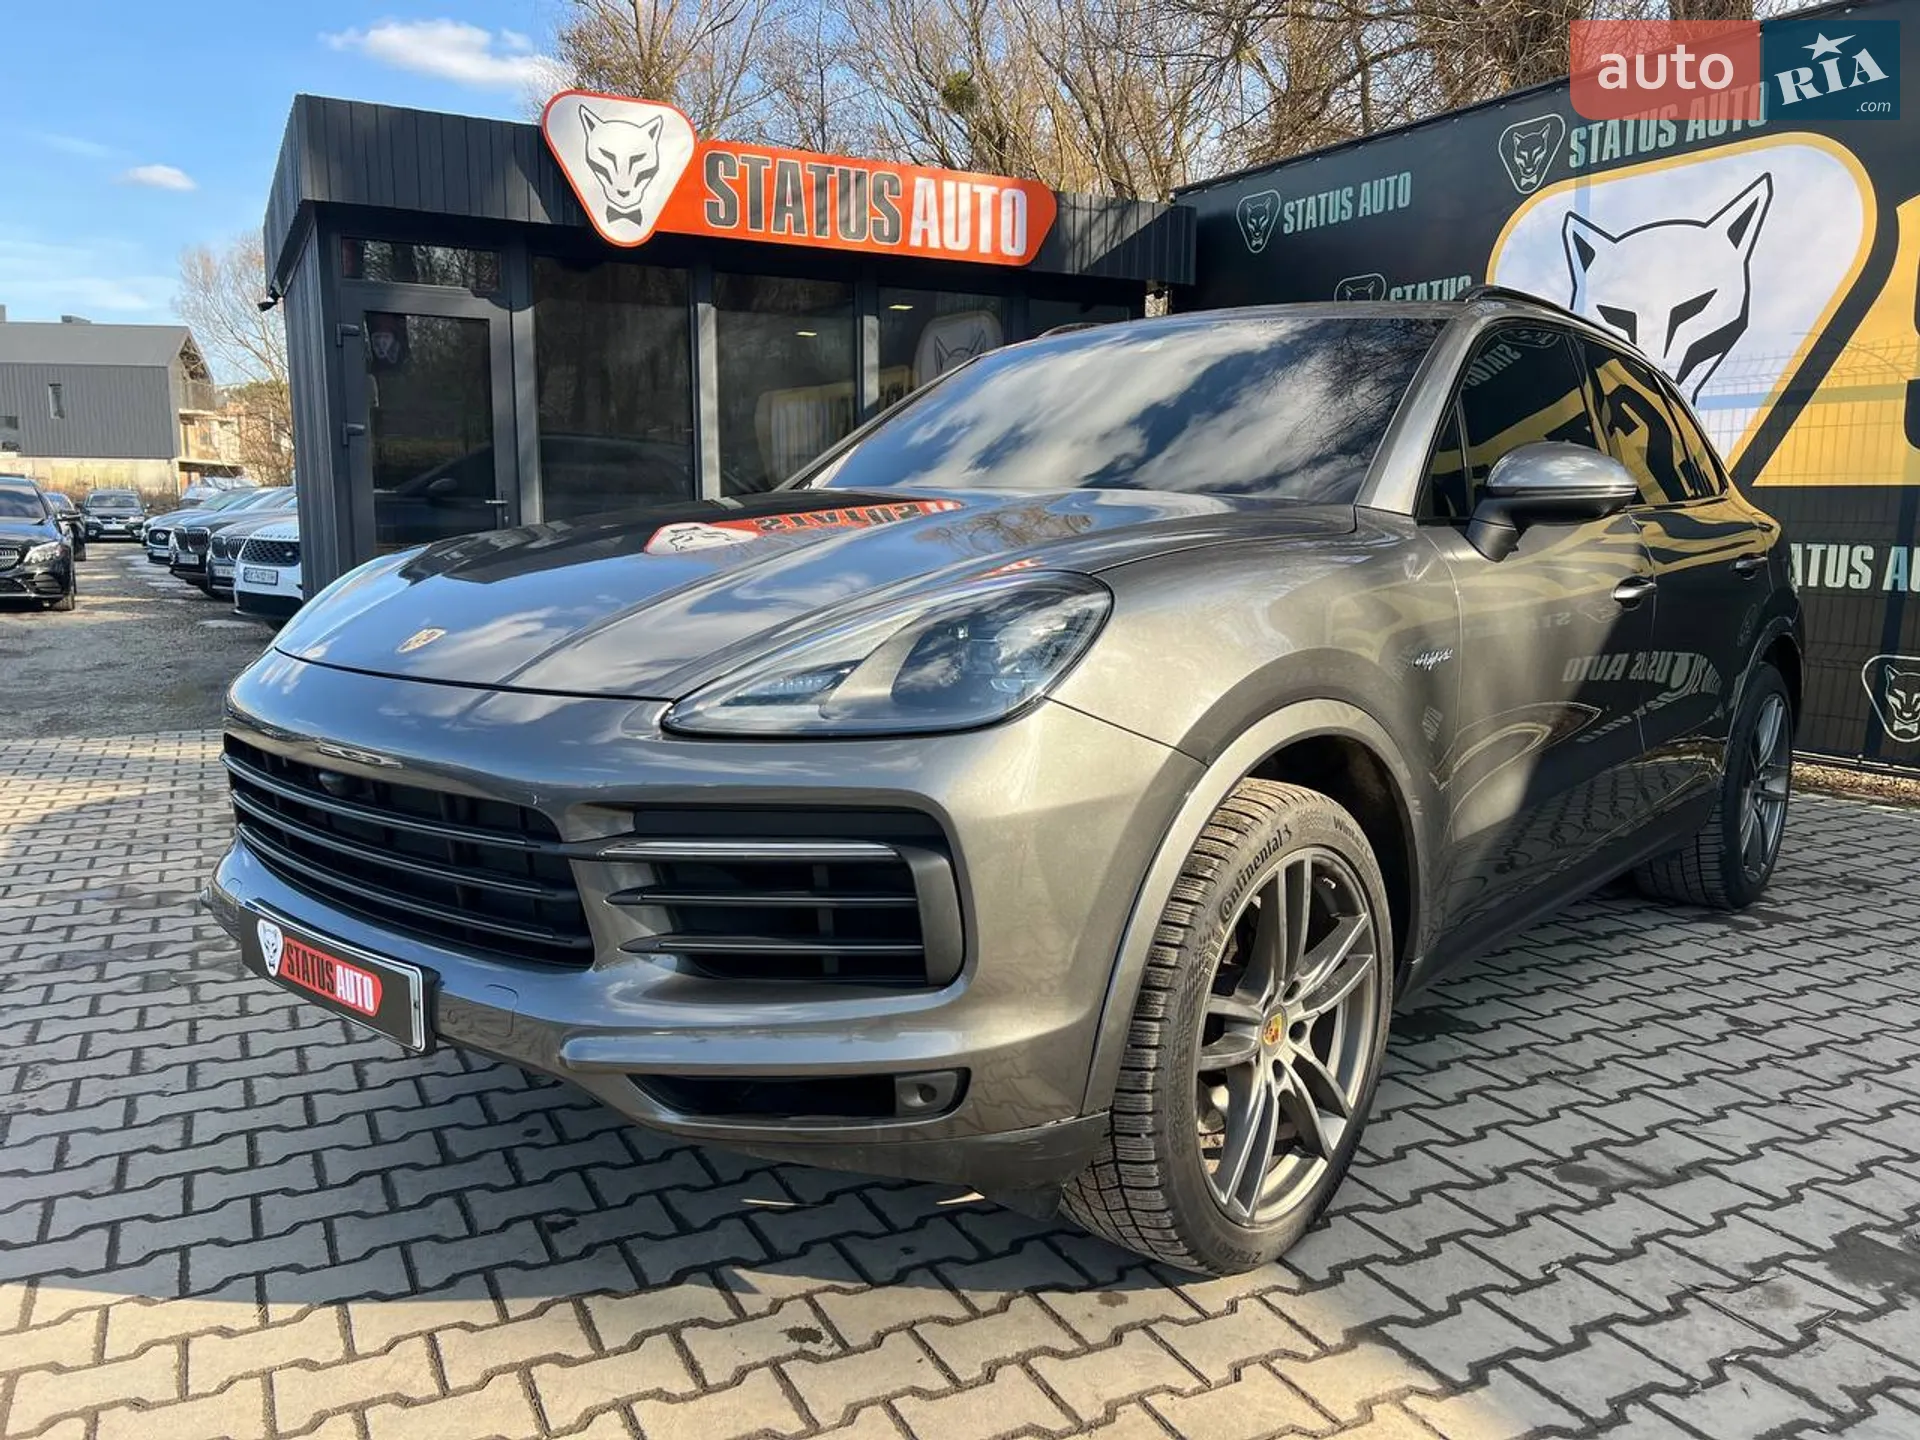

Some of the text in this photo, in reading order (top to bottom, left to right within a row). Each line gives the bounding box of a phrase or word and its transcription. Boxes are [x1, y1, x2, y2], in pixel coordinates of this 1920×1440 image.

[1569, 81, 1770, 168] STATUS AUTO
[704, 150, 1028, 257] STATUS AUTO
[1283, 171, 1412, 234] STATUS AUTO
[1788, 543, 1875, 590] ATUS
[1219, 829, 1284, 924] Continental
[286, 942, 375, 1012] STATUS AUTO
